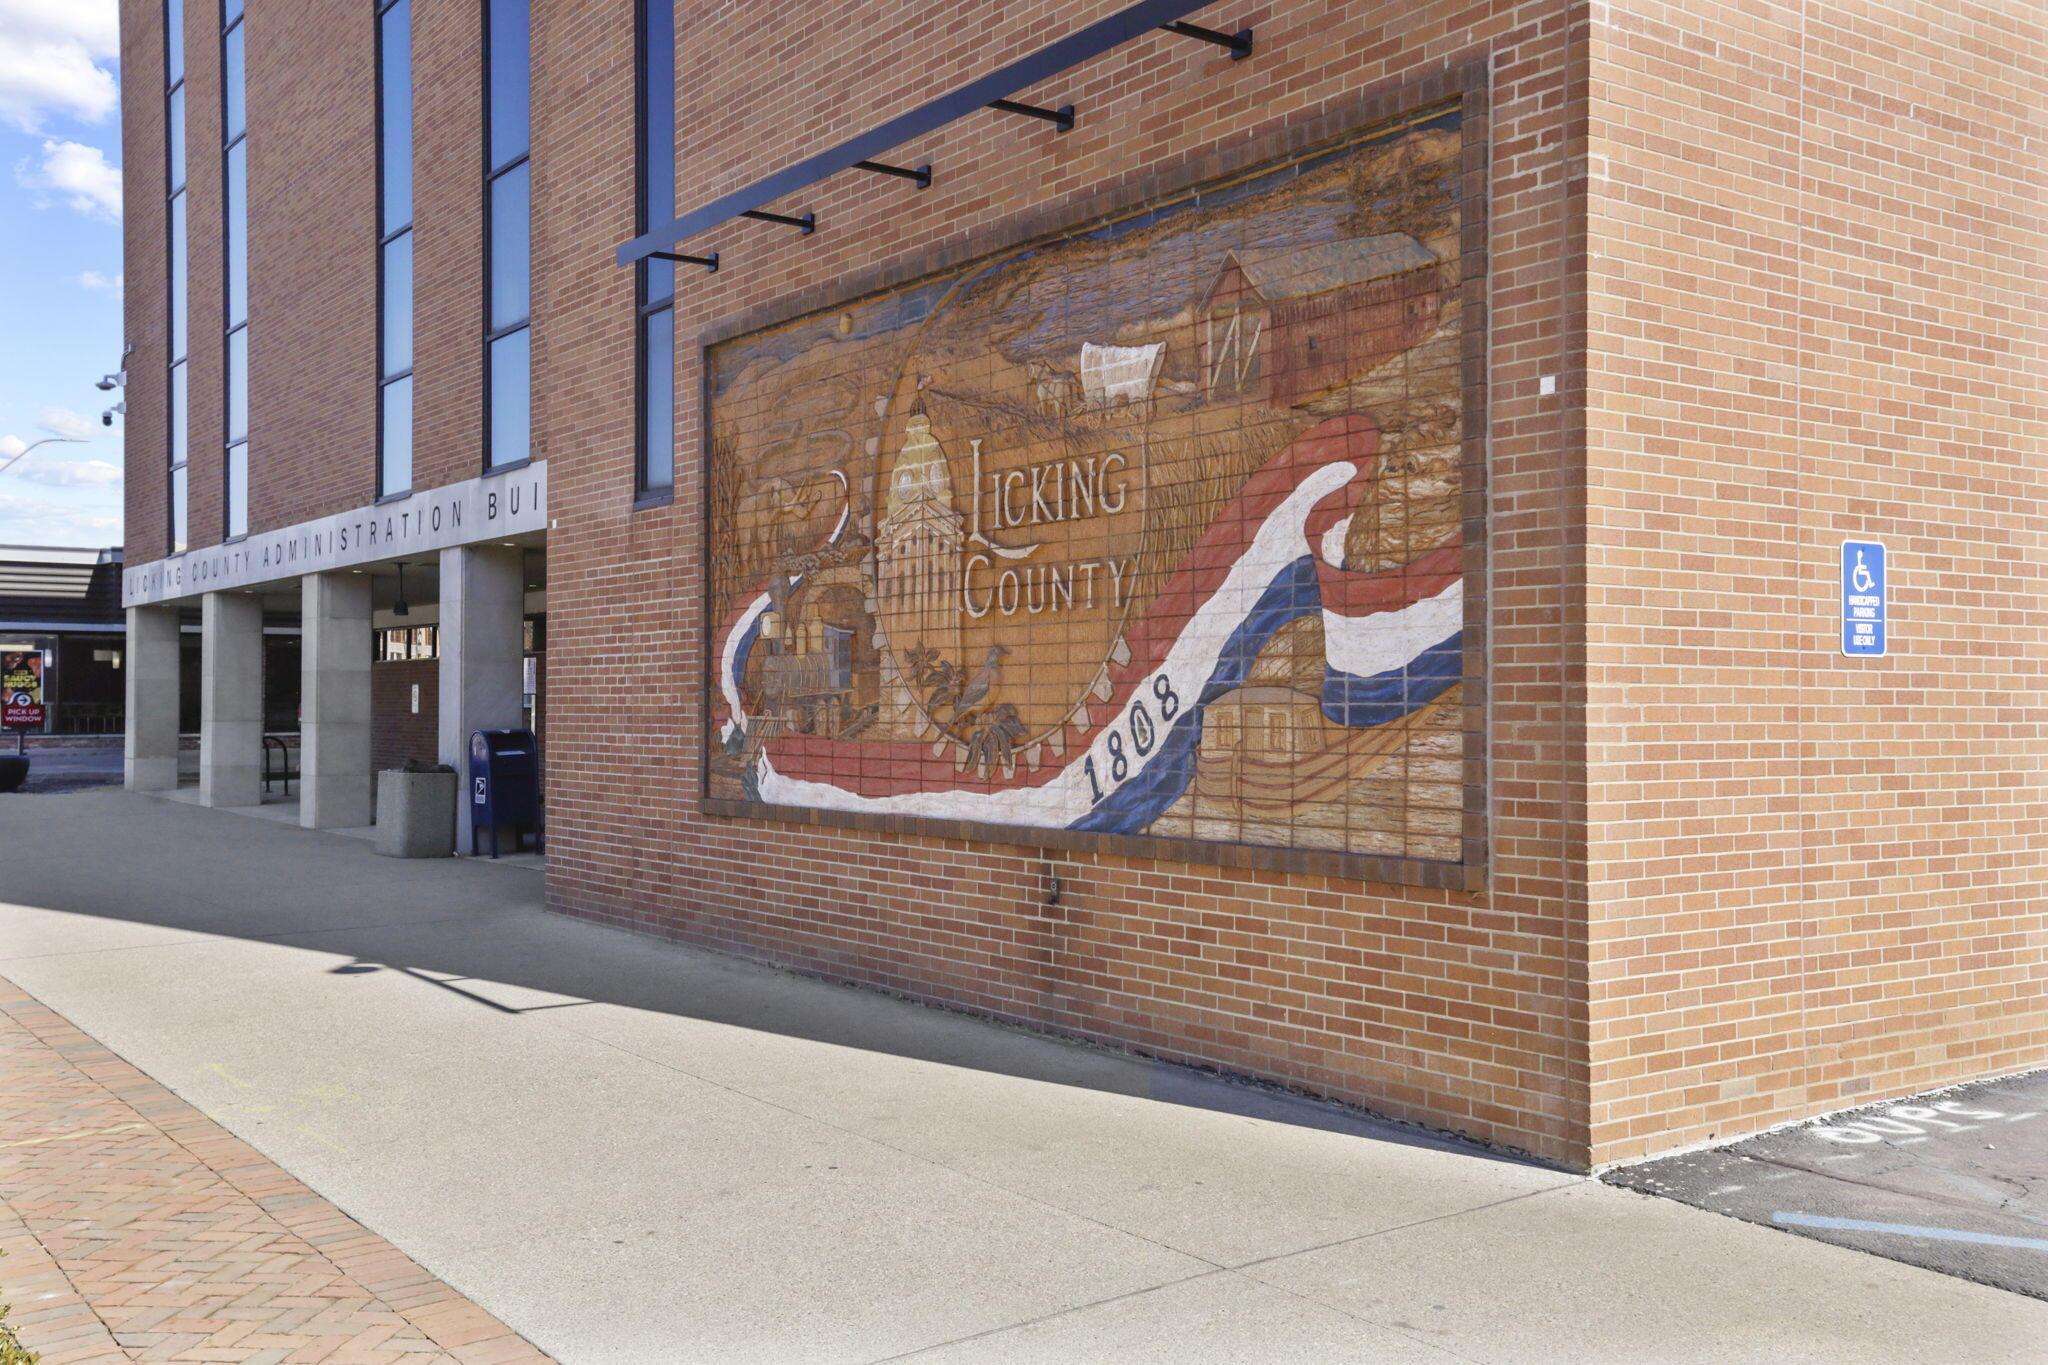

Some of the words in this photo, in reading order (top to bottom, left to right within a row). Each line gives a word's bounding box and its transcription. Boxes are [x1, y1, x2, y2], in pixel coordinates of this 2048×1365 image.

[129, 567, 182, 596] LICKING
[192, 551, 250, 582] COUNTY
[263, 500, 462, 568] ADMINISTRATION
[488, 482, 538, 521] BUI
[969, 438, 1127, 560] LICKING
[964, 554, 1127, 618] COUNTY
[1853, 607, 1876, 618] PARKING
[1084, 673, 1179, 806] 1808
